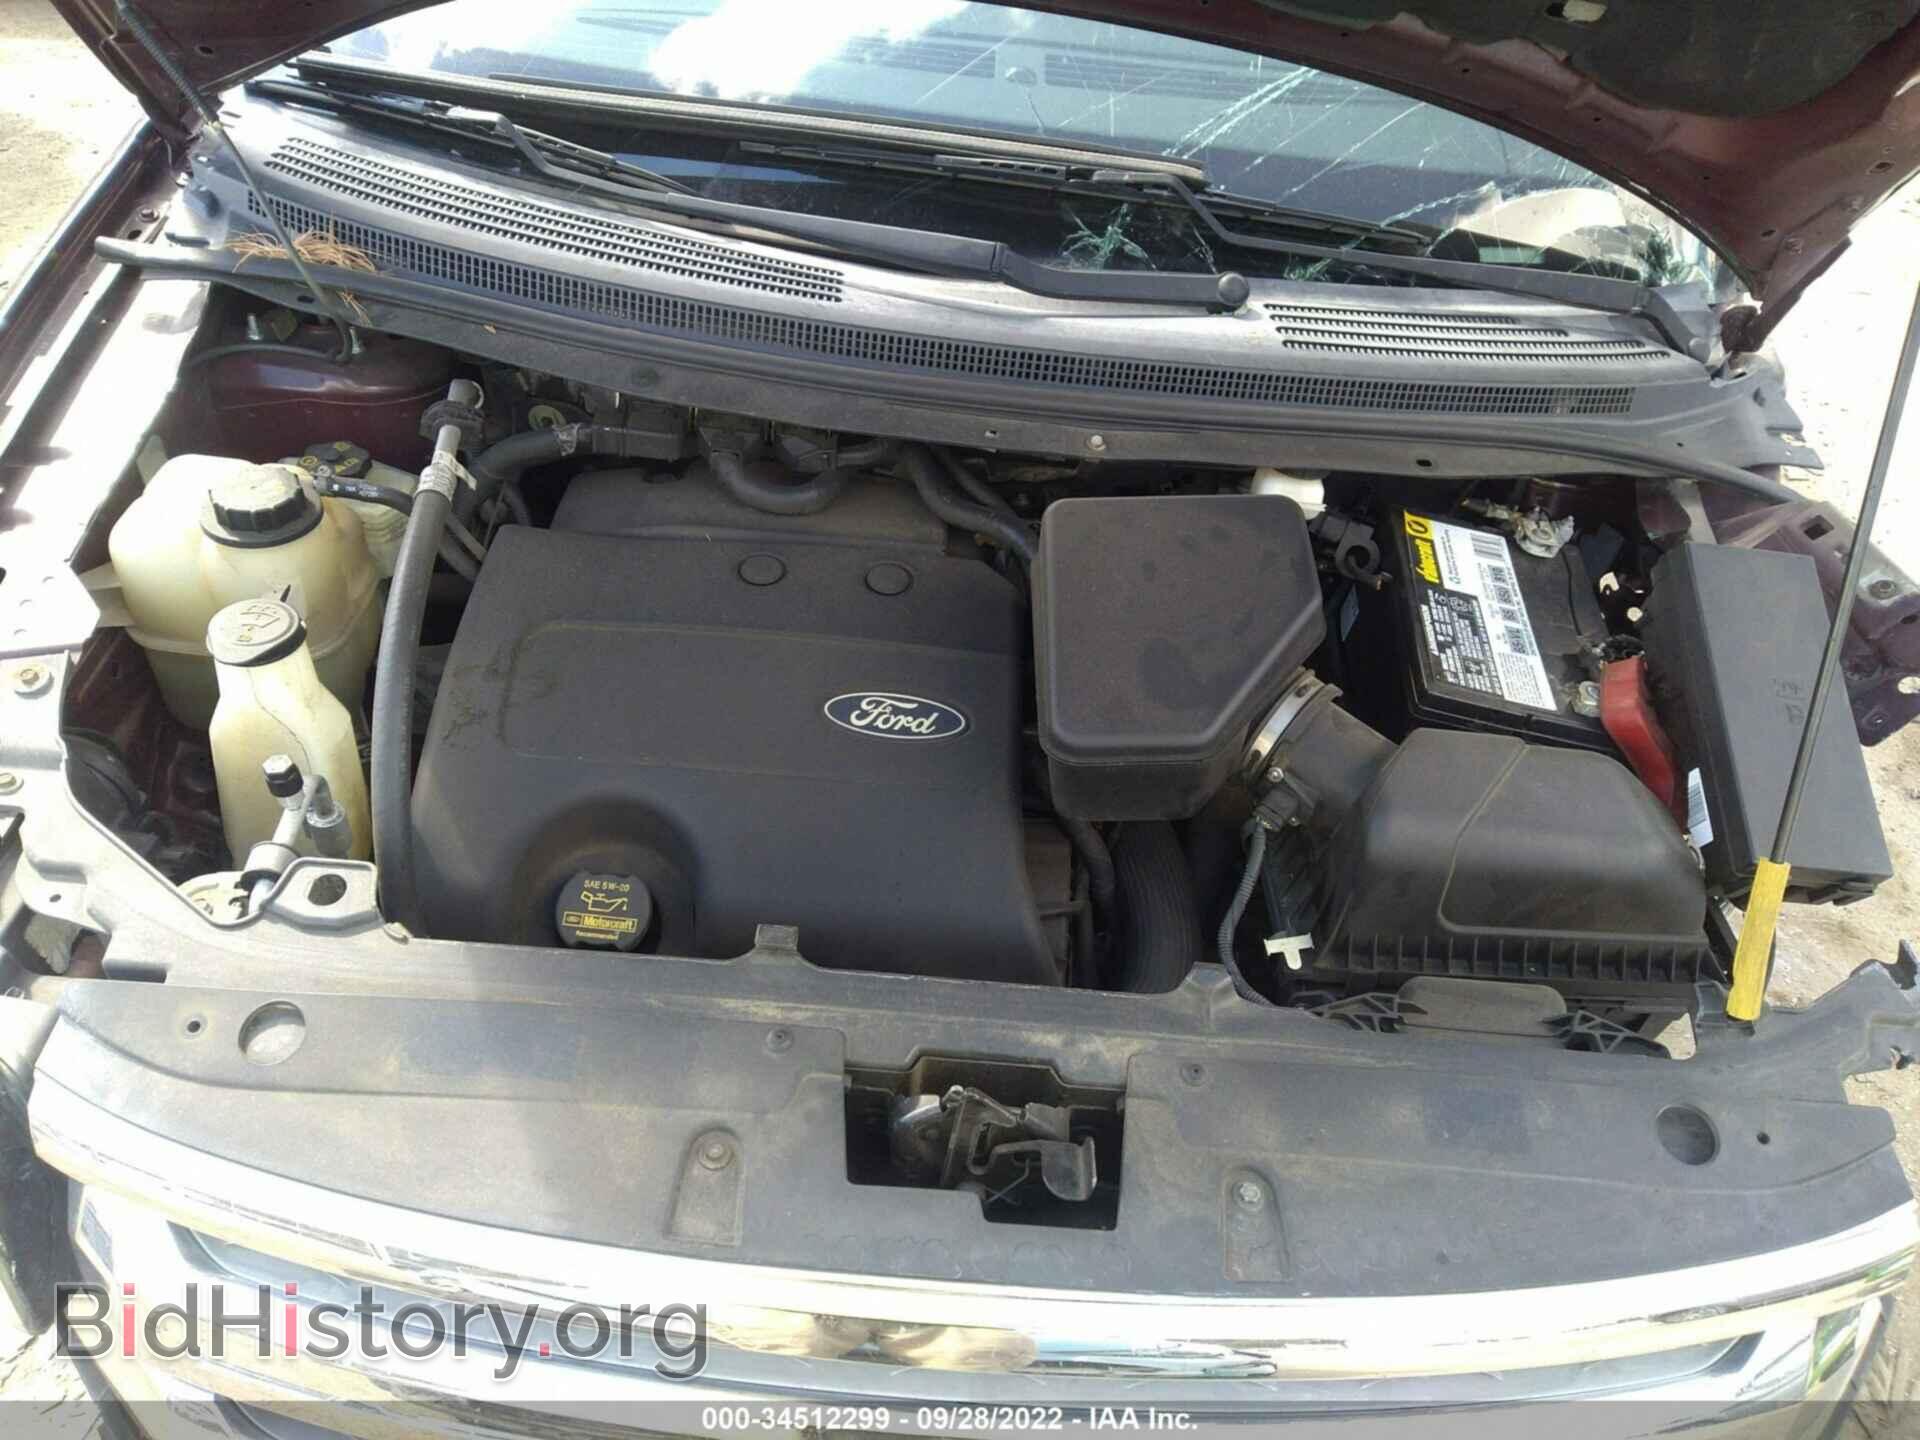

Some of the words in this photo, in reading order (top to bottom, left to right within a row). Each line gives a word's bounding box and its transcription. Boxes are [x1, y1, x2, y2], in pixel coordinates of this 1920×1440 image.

[850, 696, 939, 734] Ford
[584, 880, 601, 889] SAE
[602, 880, 630, 892] 5W-20
[583, 915, 633, 930] Motorcraft
